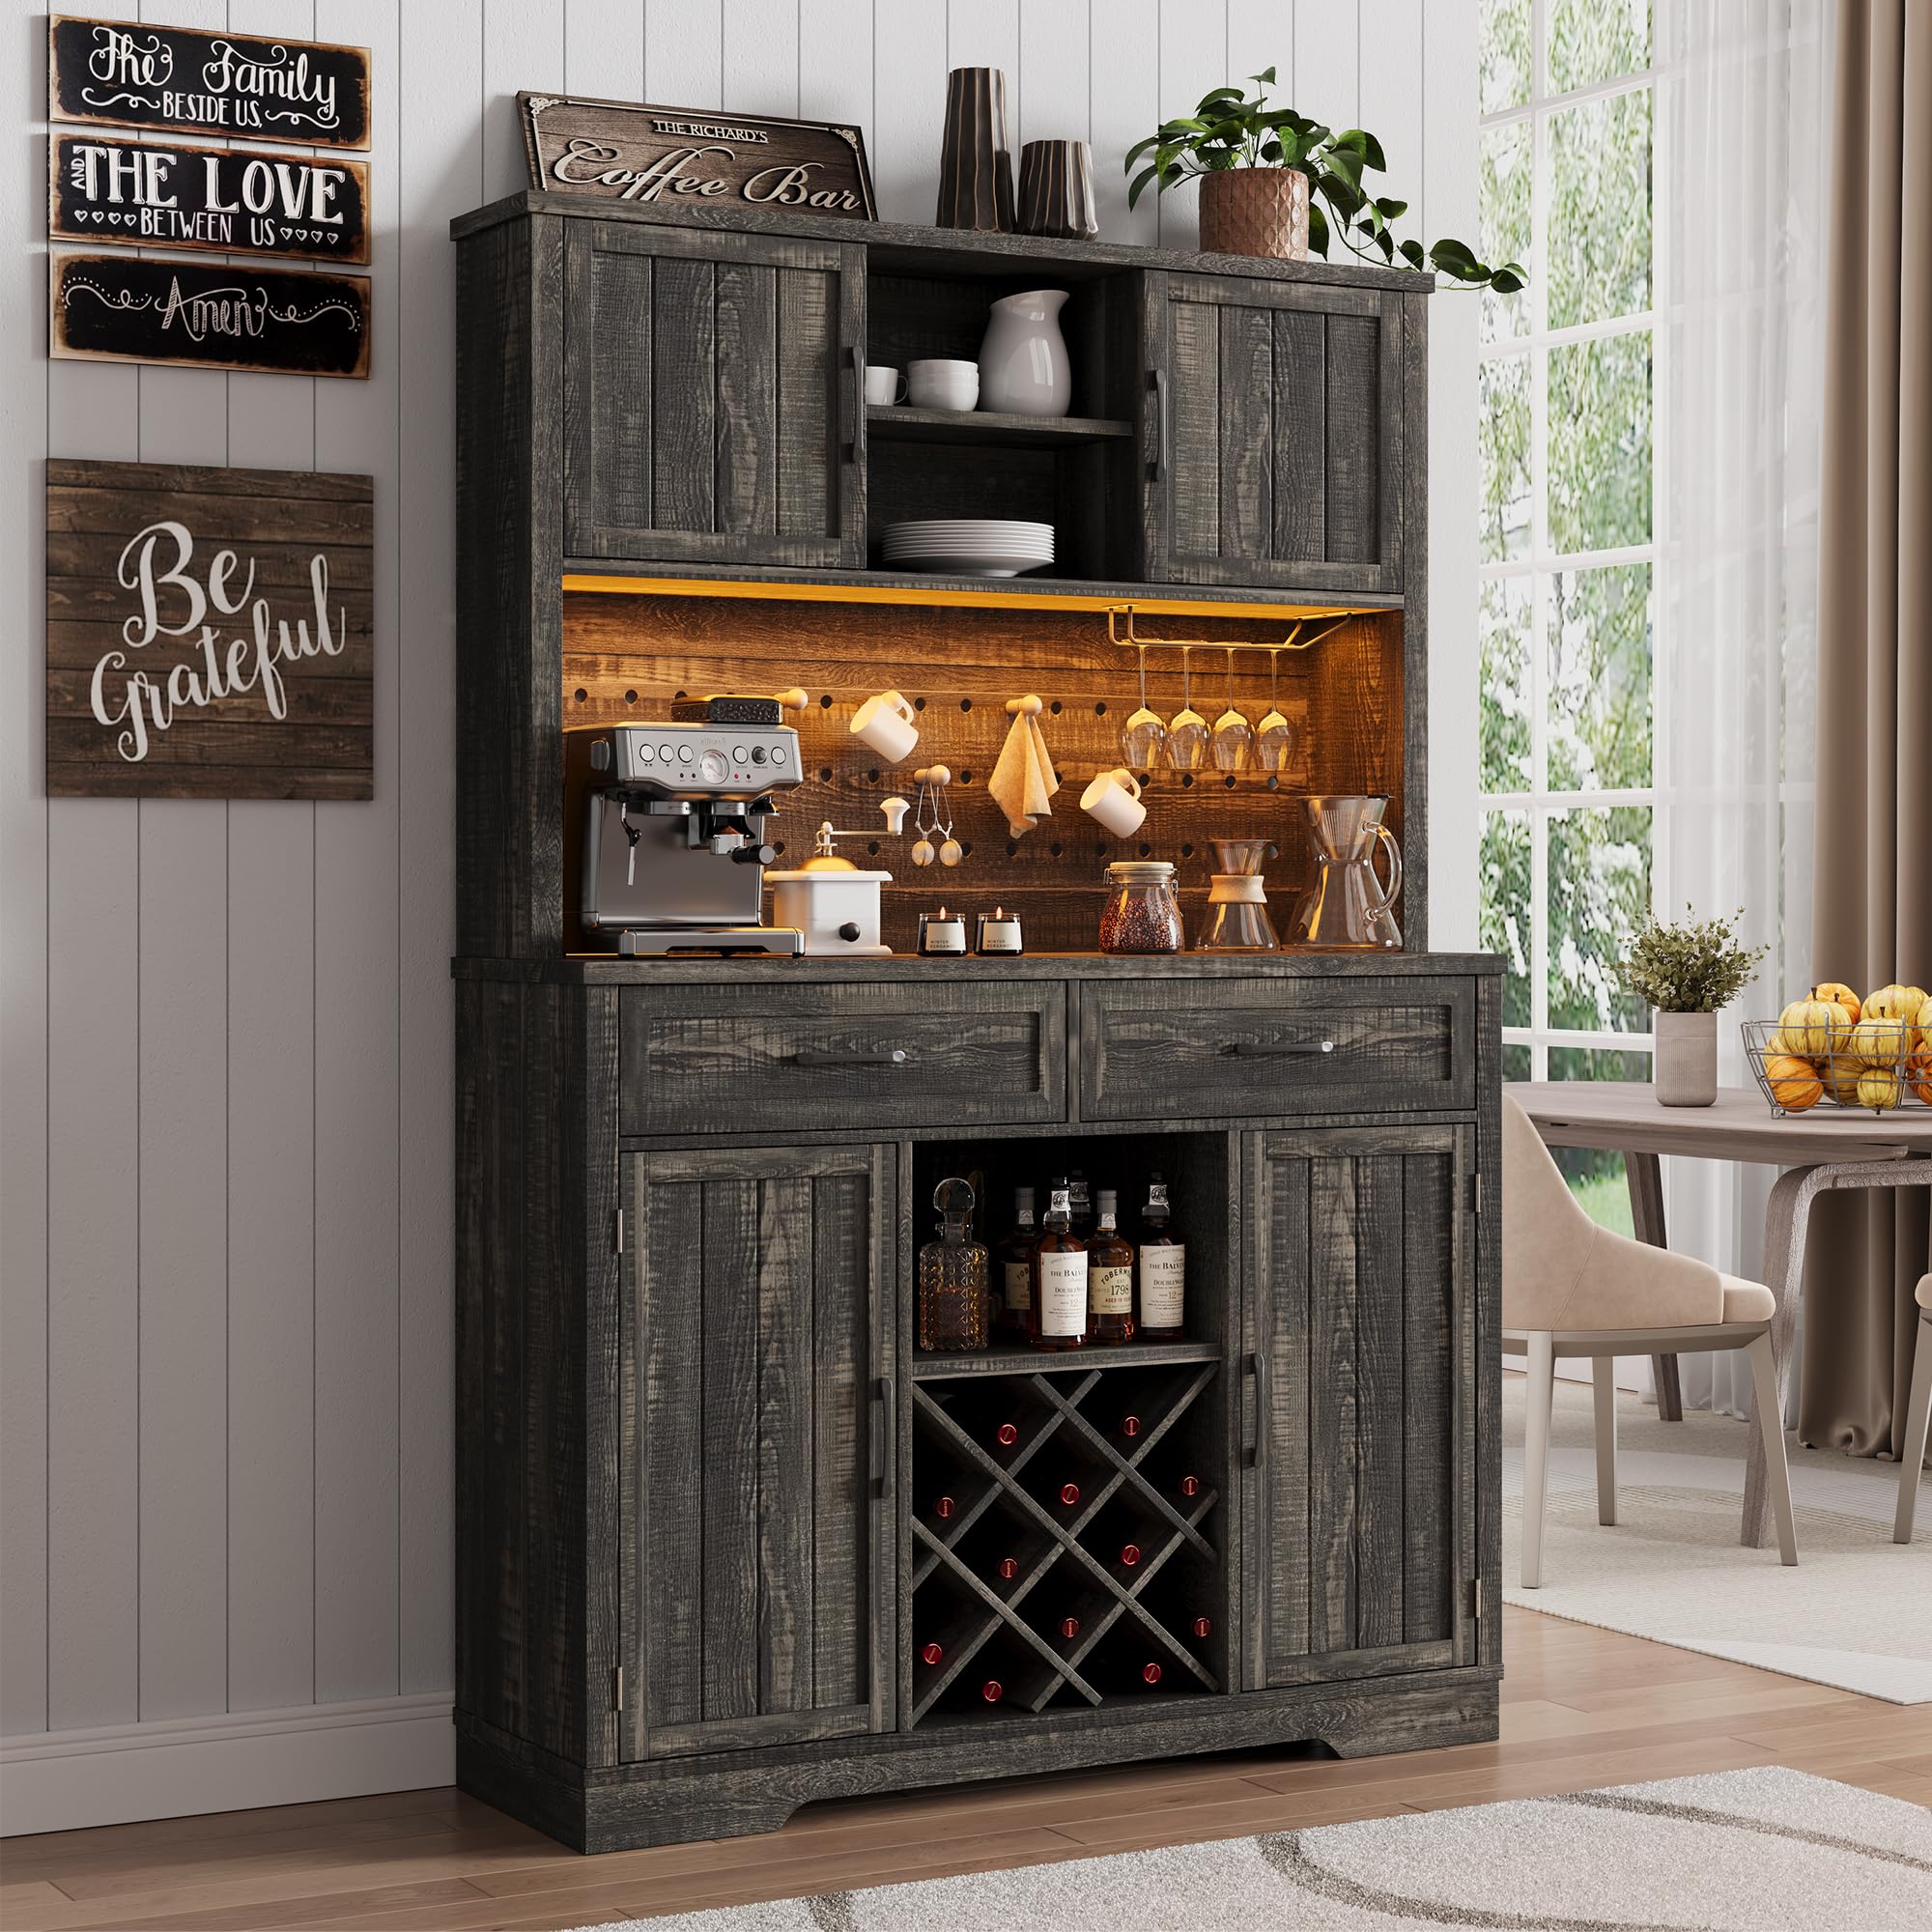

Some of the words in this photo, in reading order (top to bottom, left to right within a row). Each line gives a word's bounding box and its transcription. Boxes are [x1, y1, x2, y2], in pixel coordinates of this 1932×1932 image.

[89, 26, 173, 86] The
[202, 41, 336, 119] Family
[162, 93, 230, 125] BESIDE
[235, 99, 263, 128] US,
[653, 120, 687, 134] THE
[690, 124, 769, 144] RICHARD'S
[71, 157, 86, 190] AND
[72, 145, 178, 209] THE
[202, 156, 346, 224] LOVE
[554, 138, 736, 202] Coffee
[743, 162, 862, 211] Bar
[140, 209, 232, 242] BETWEEN
[250, 217, 275, 245] US
[117, 521, 255, 648] Be
[90, 554, 346, 762] Grateful
[1111, 1284, 1129, 1295] 1798
[1168, 1291, 1178, 1300] 12
